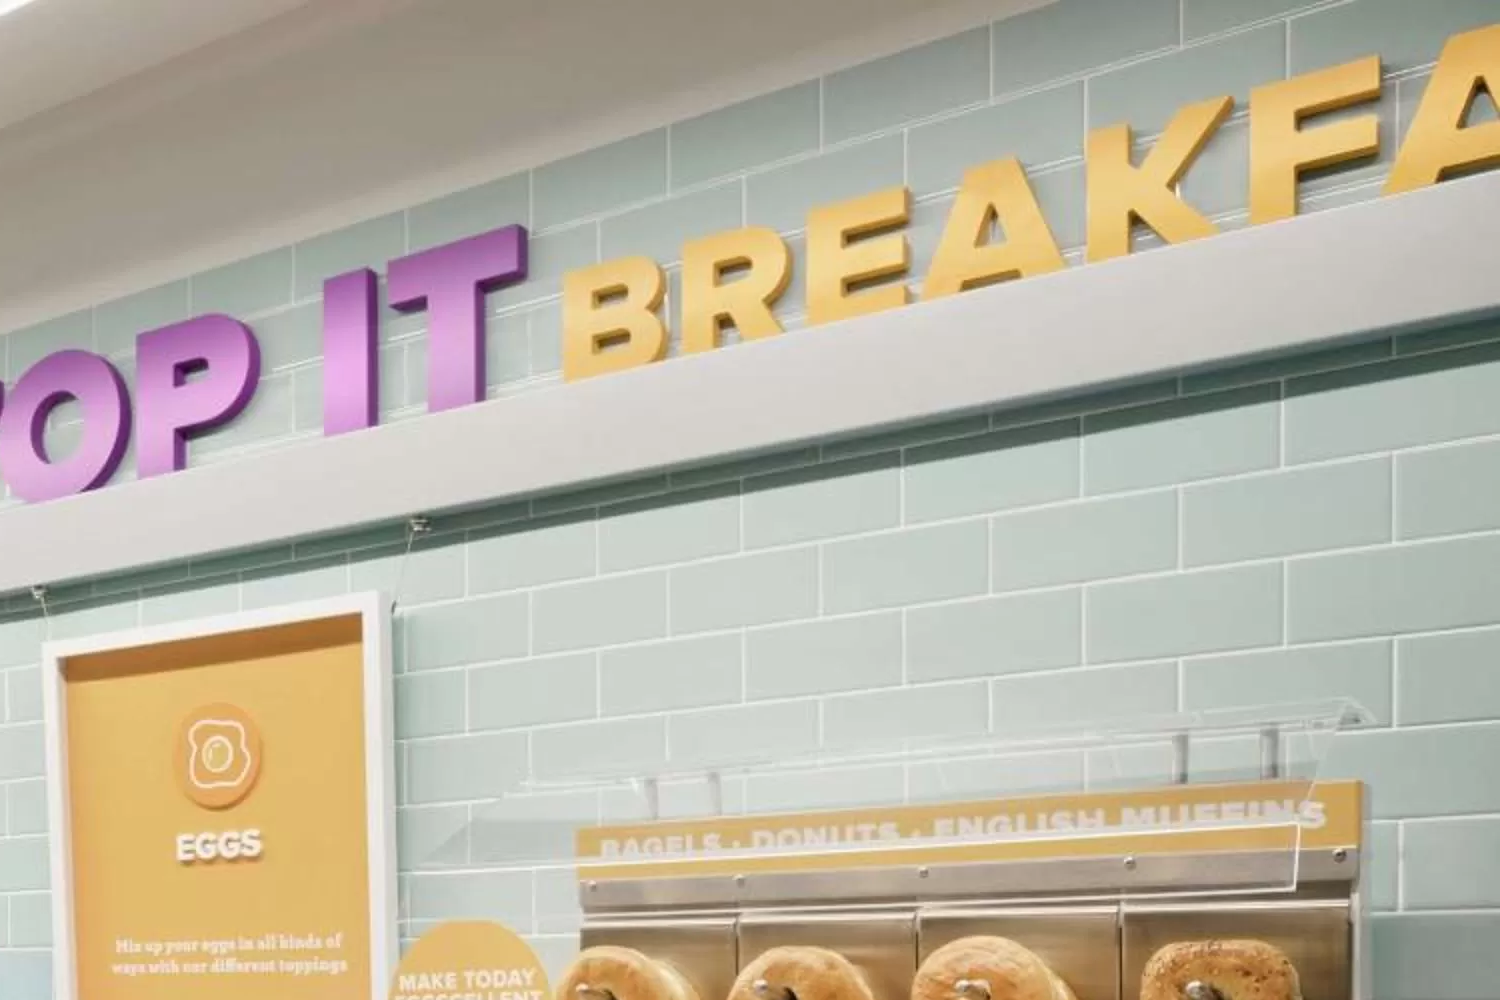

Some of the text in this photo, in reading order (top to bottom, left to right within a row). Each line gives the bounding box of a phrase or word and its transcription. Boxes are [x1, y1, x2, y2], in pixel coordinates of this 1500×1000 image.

[323, 224, 528, 437] IT
[600, 798, 1328, 861] BAGELS DONUTS ENGLISH MUFFINS
[175, 828, 263, 864] EGGS
[164, 940, 198, 956] your
[201, 939, 234, 955] eggs
[279, 955, 348, 976] toppings
[399, 968, 537, 992] MAKE TODAY
